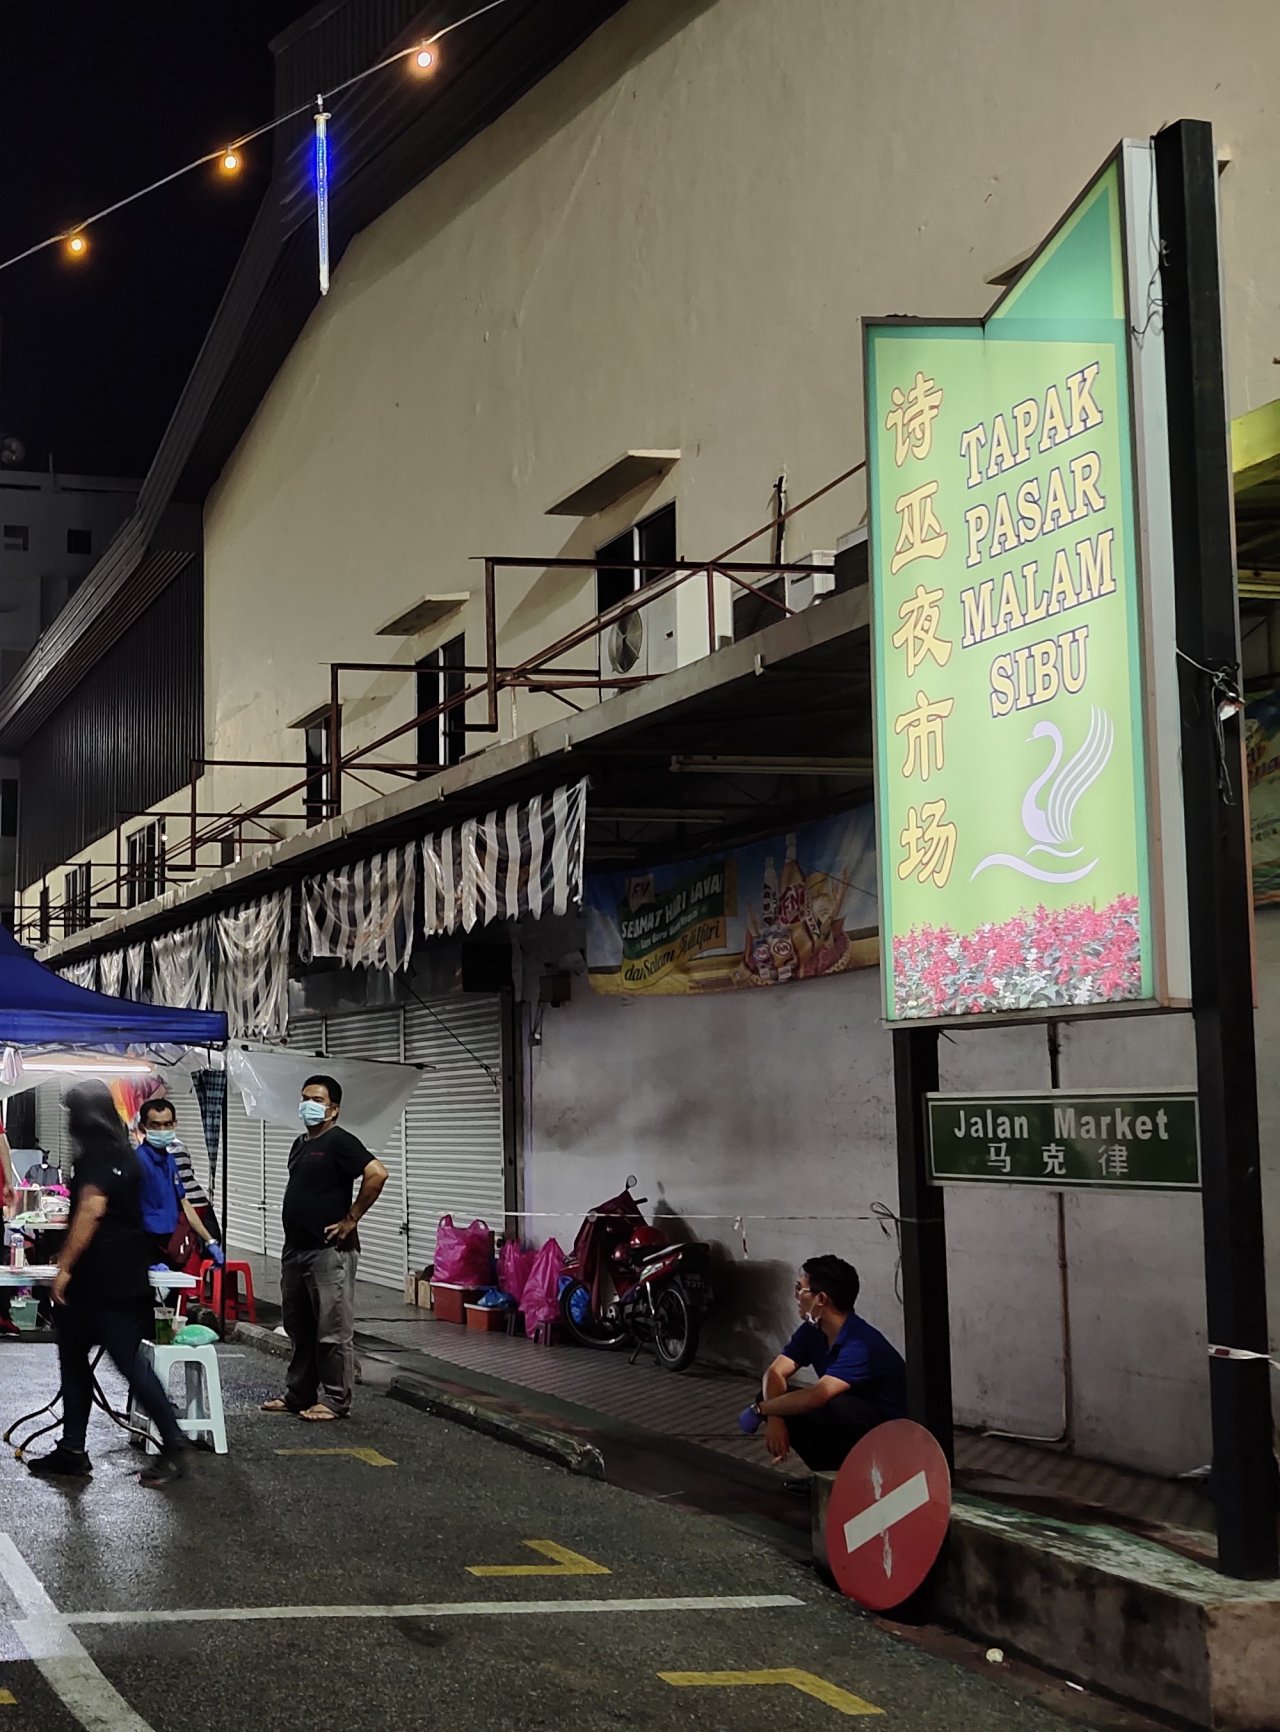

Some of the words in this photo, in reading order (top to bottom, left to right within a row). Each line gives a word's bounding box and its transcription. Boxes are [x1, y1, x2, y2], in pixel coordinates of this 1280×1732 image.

[960, 360, 1104, 489] TAPAK
[964, 450, 1107, 567] PASAR
[884, 370, 958, 889] 诗巫夜市场
[960, 528, 1117, 648] MALAM
[989, 624, 1089, 718] SIBU
[953, 1109, 1029, 1139] Jalan
[1053, 1107, 1169, 1140] Market
[987, 1142, 1129, 1176] 马克律
